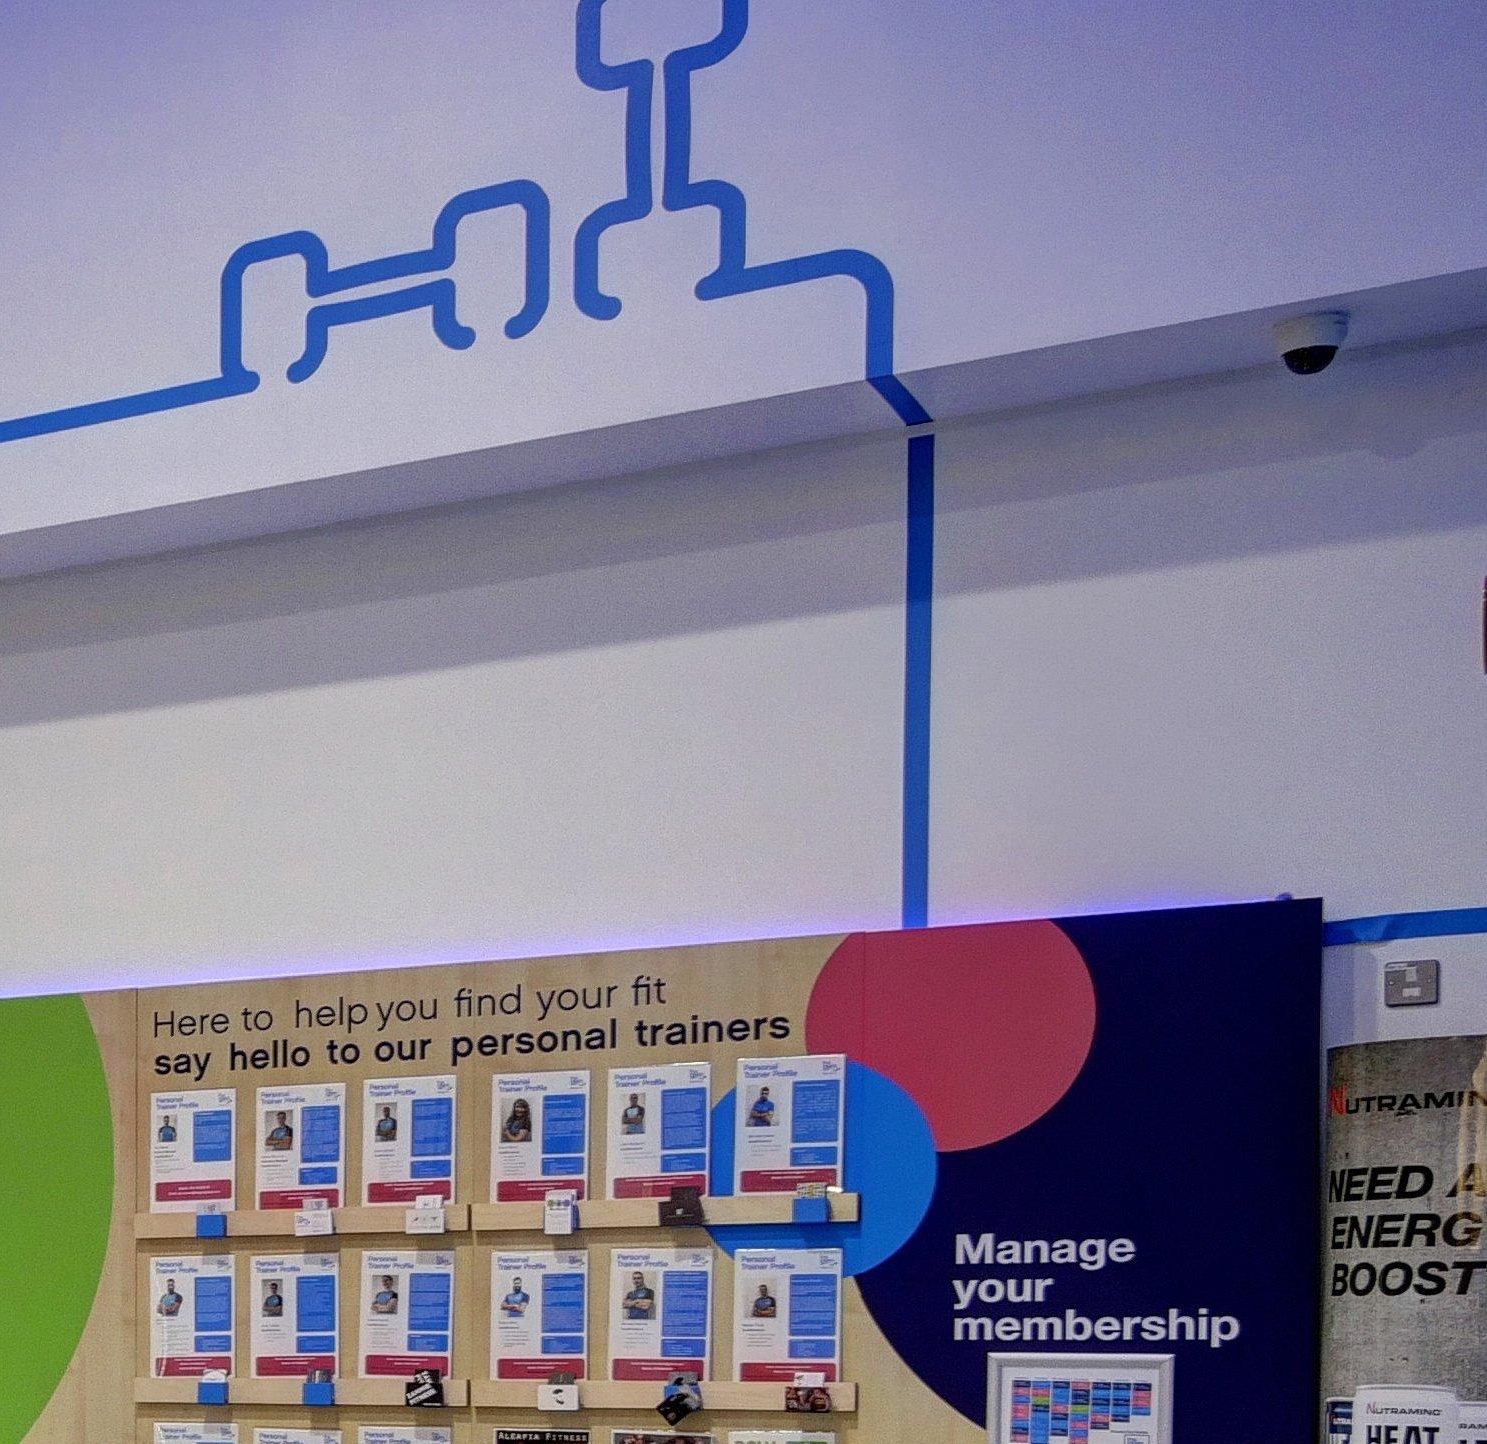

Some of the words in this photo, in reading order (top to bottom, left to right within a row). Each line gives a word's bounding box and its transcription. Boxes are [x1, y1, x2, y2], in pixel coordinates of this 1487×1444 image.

[154, 1010, 229, 1037] Here
[242, 1007, 273, 1031] to
[295, 996, 368, 1033] help
[376, 998, 438, 1032] you
[454, 984, 522, 1018] find
[536, 984, 618, 1021] your
[632, 975, 666, 1006] fit
[155, 1052, 212, 1081] say
[230, 1039, 310, 1071] hello
[326, 1039, 360, 1065] to
[375, 1038, 432, 1062] our
[452, 1018, 617, 1067] personal
[634, 1014, 791, 1047] trainers
[1329, 1165, 1434, 1202] NEED
[1331, 1212, 1483, 1250] ENERG
[954, 1233, 1136, 1271] Manage
[952, 1277, 1055, 1310] your
[1331, 1261, 1487, 1297] BOOST
[953, 1308, 1241, 1348] membership
